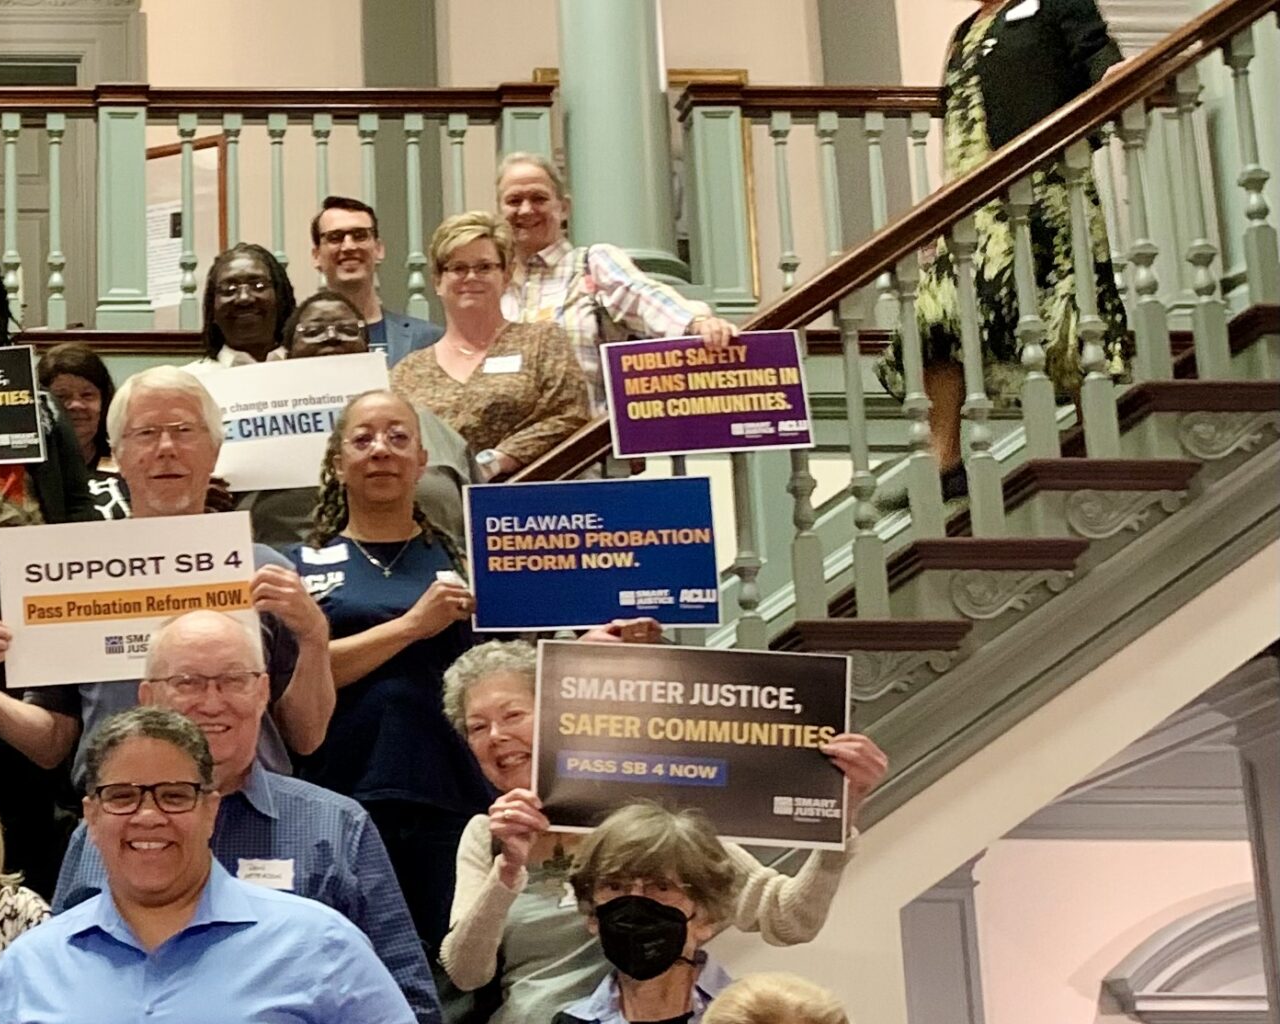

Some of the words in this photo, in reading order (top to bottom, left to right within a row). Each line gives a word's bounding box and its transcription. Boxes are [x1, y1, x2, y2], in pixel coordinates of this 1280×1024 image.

[622, 350, 684, 372] PUBLIC
[686, 345, 747, 366] SAFETY
[624, 374, 686, 396] MEANS
[688, 369, 778, 390] INVESTING
[780, 367, 800, 384] IN
[230, 398, 268, 413] change
[270, 400, 289, 409] our
[292, 394, 344, 408] probation
[627, 400, 665, 420] OUR
[667, 392, 792, 416] COMMUNITIES.
[238, 412, 324, 438] CHANGE
[486, 513, 604, 534] DELAWARE:
[487, 533, 580, 551] DEMAND
[586, 528, 710, 548] PROBATION
[25, 556, 166, 583] SUPPORT
[175, 552, 214, 573] SB
[224, 550, 242, 568] 4
[488, 556, 577, 572] REFORM
[581, 552, 640, 569] NOW.
[27, 602, 62, 620] Pass
[67, 598, 142, 617] Probation
[146, 594, 202, 612] Reform
[206, 589, 248, 607] NOW.
[560, 676, 684, 705] SMARTER
[689, 682, 802, 714] JUSTICE,
[559, 713, 640, 739] SAFER
[648, 717, 836, 748] COMMUNITIES
[566, 758, 618, 774] PASS
[622, 762, 648, 775] SB
[652, 762, 665, 775] 4
[670, 764, 718, 779] NOW
